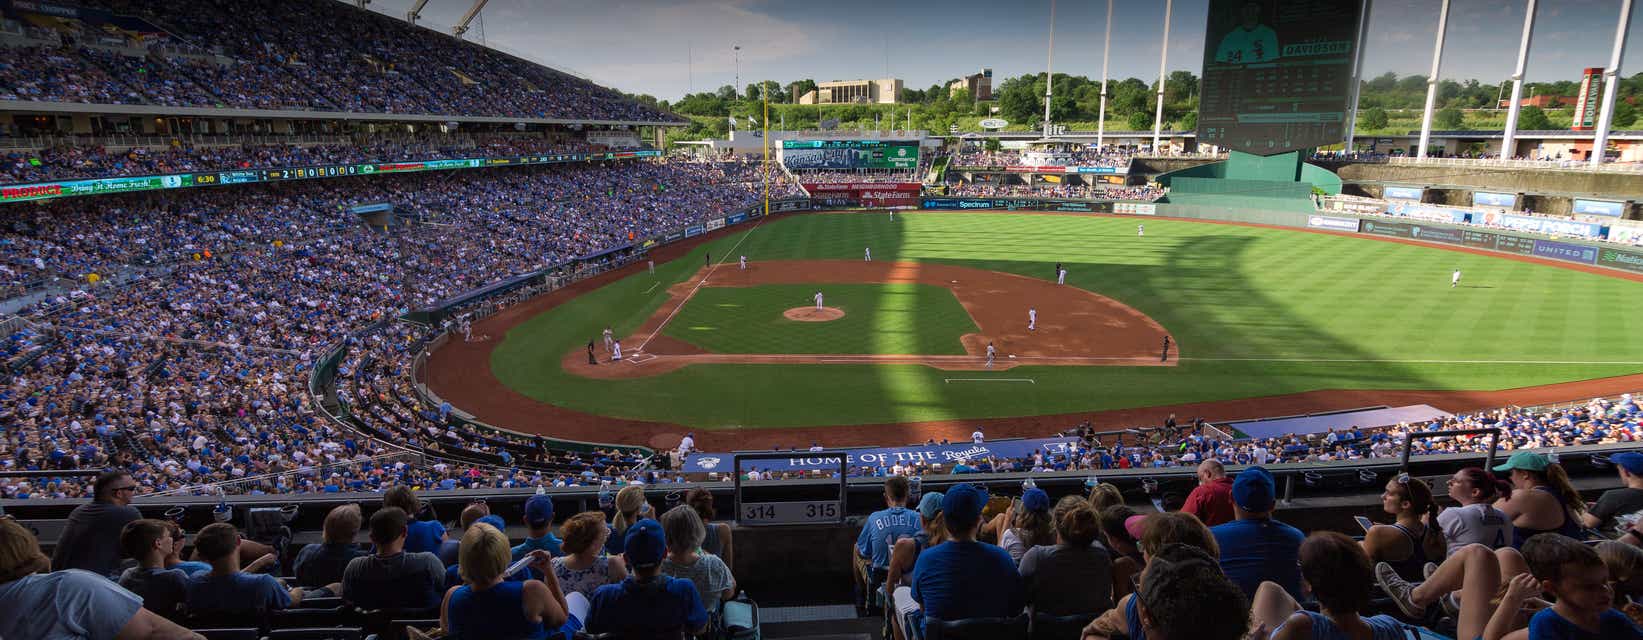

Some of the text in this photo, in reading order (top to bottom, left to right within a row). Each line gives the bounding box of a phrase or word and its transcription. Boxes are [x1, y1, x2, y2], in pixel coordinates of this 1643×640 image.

[197, 175, 215, 184] 6:30
[1538, 245, 1581, 258] UNITED
[789, 445, 991, 467] HOME OF THE Royals
[746, 503, 836, 520] 314 315
